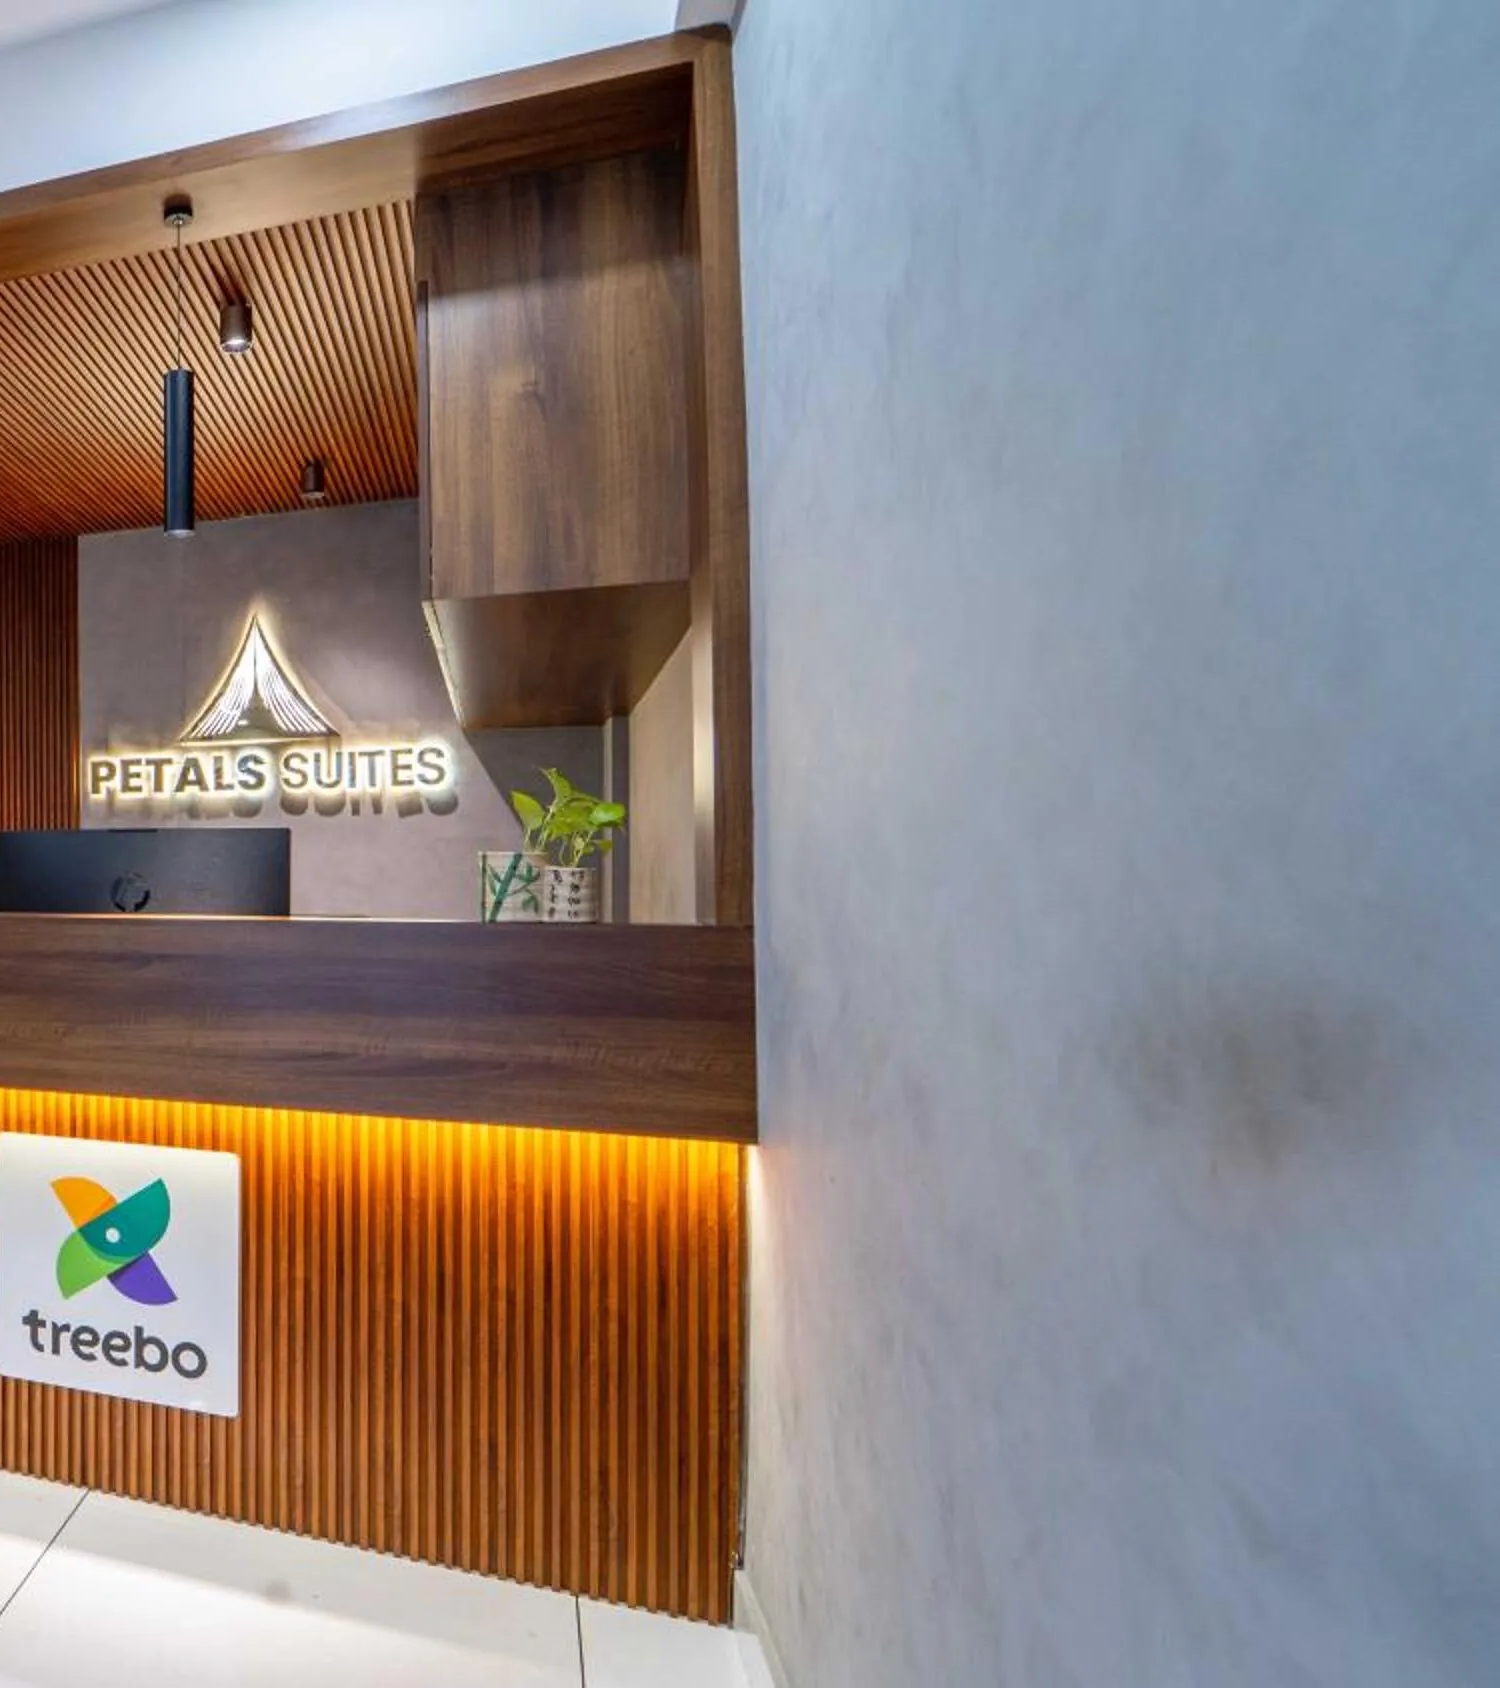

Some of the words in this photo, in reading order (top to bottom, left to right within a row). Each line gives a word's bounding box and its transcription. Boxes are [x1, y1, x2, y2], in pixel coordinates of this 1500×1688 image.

[90, 753, 267, 796] PETALS
[280, 746, 447, 790] SUITES
[21, 1309, 208, 1379] treebo
